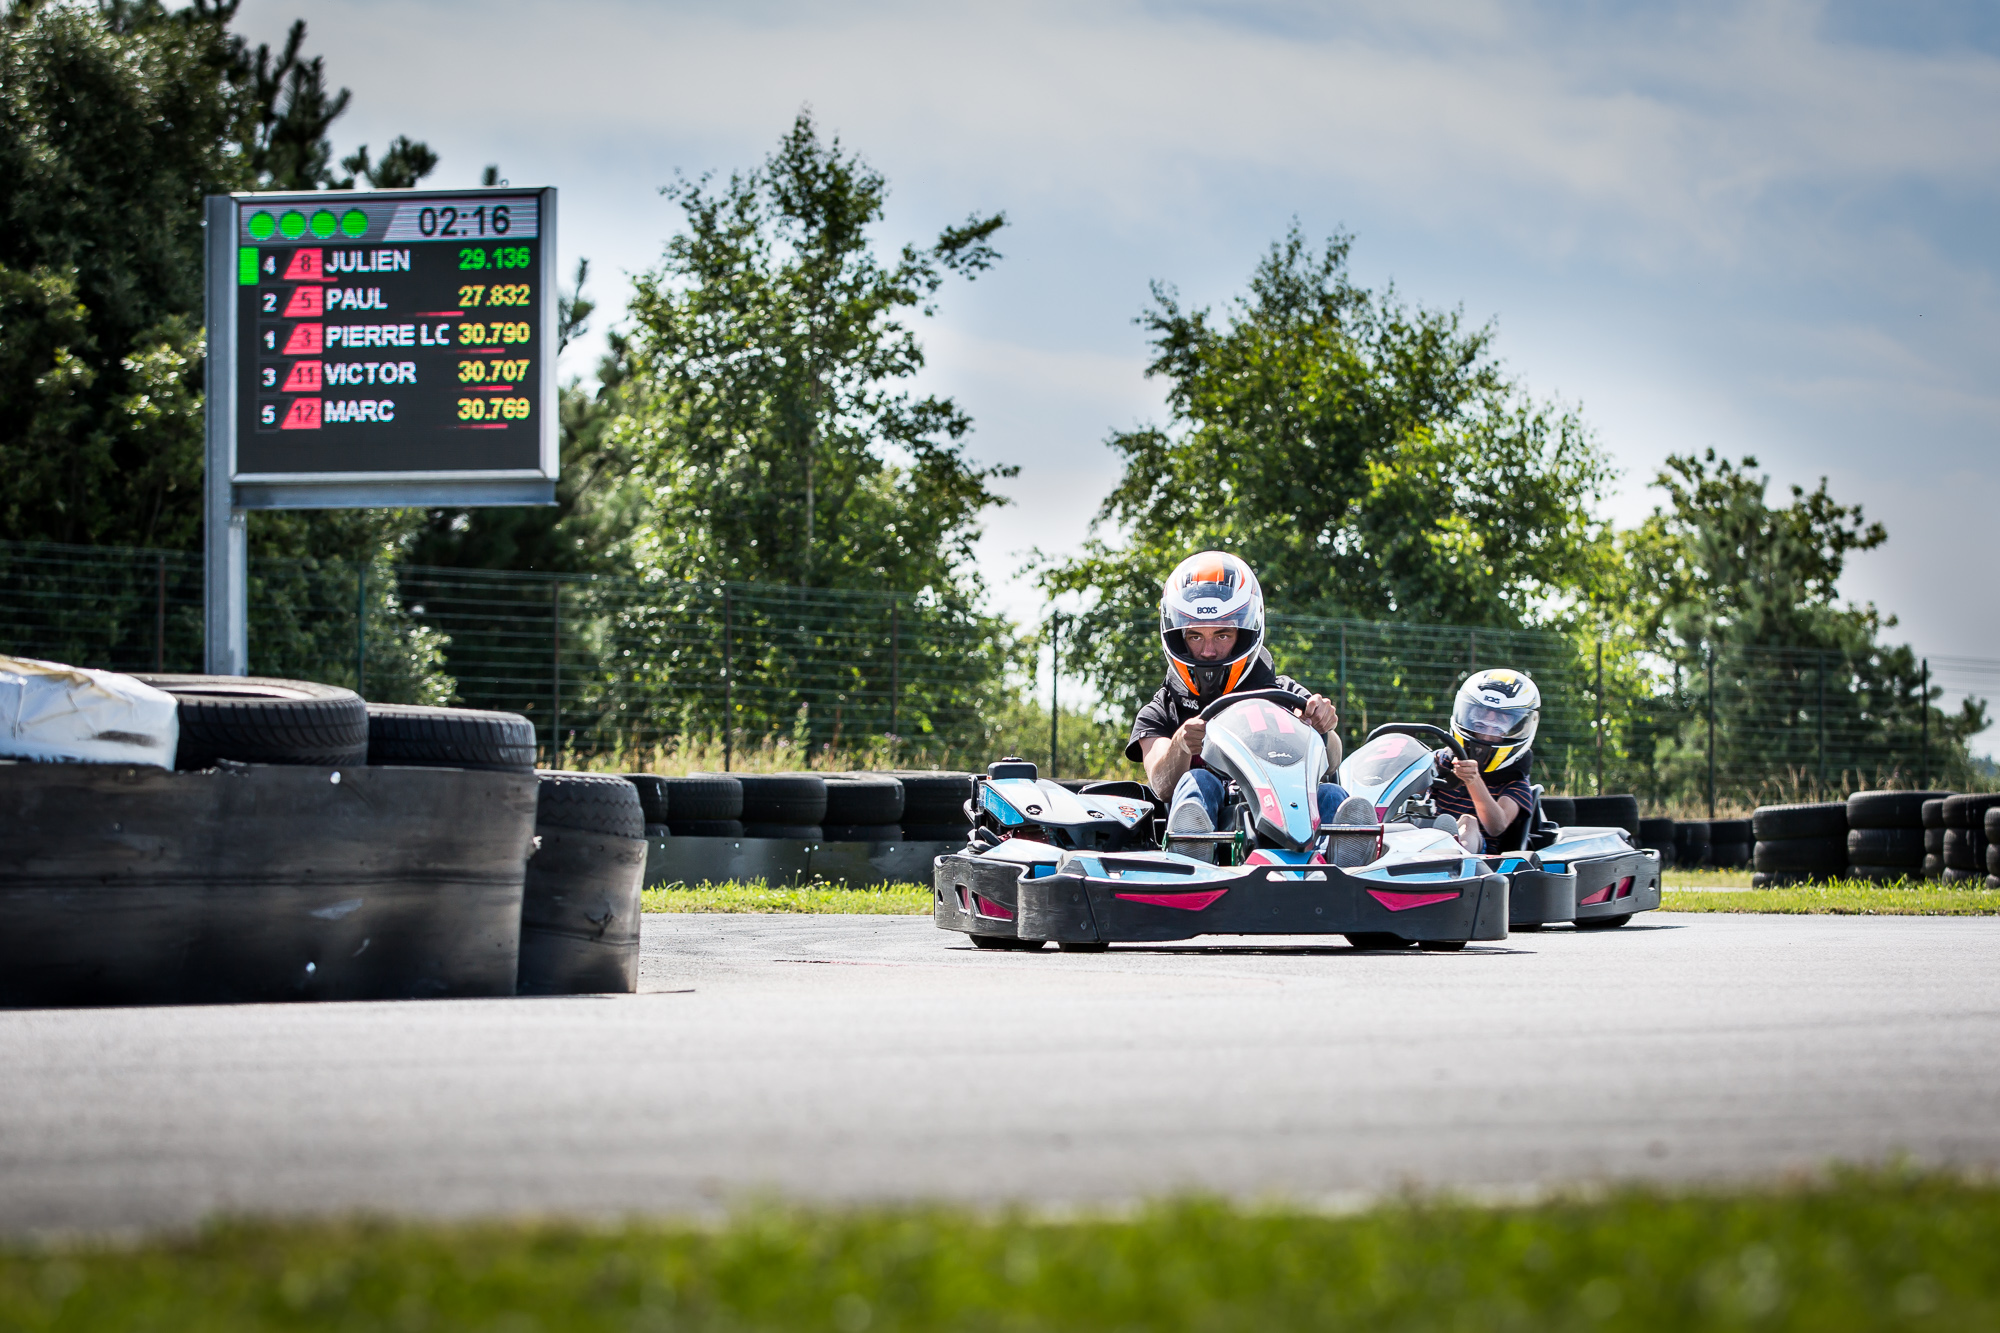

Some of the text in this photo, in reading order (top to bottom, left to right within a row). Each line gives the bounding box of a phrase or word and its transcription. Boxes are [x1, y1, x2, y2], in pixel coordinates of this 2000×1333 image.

[419, 205, 511, 237] 02:16
[263, 246, 531, 275] 4 8 JULIEN 29.136
[262, 284, 531, 312] 2 5 PAUL 27.832
[263, 321, 531, 349] 1 3 PIERRE LC 30.790
[262, 359, 531, 387] 3 11 VICTOR 30.707
[261, 404, 276, 425] 5
[324, 399, 396, 423] MARC
[457, 397, 531, 420] 30.769
[1196, 606, 1218, 614] BOXS
[1236, 704, 1296, 734] 11
